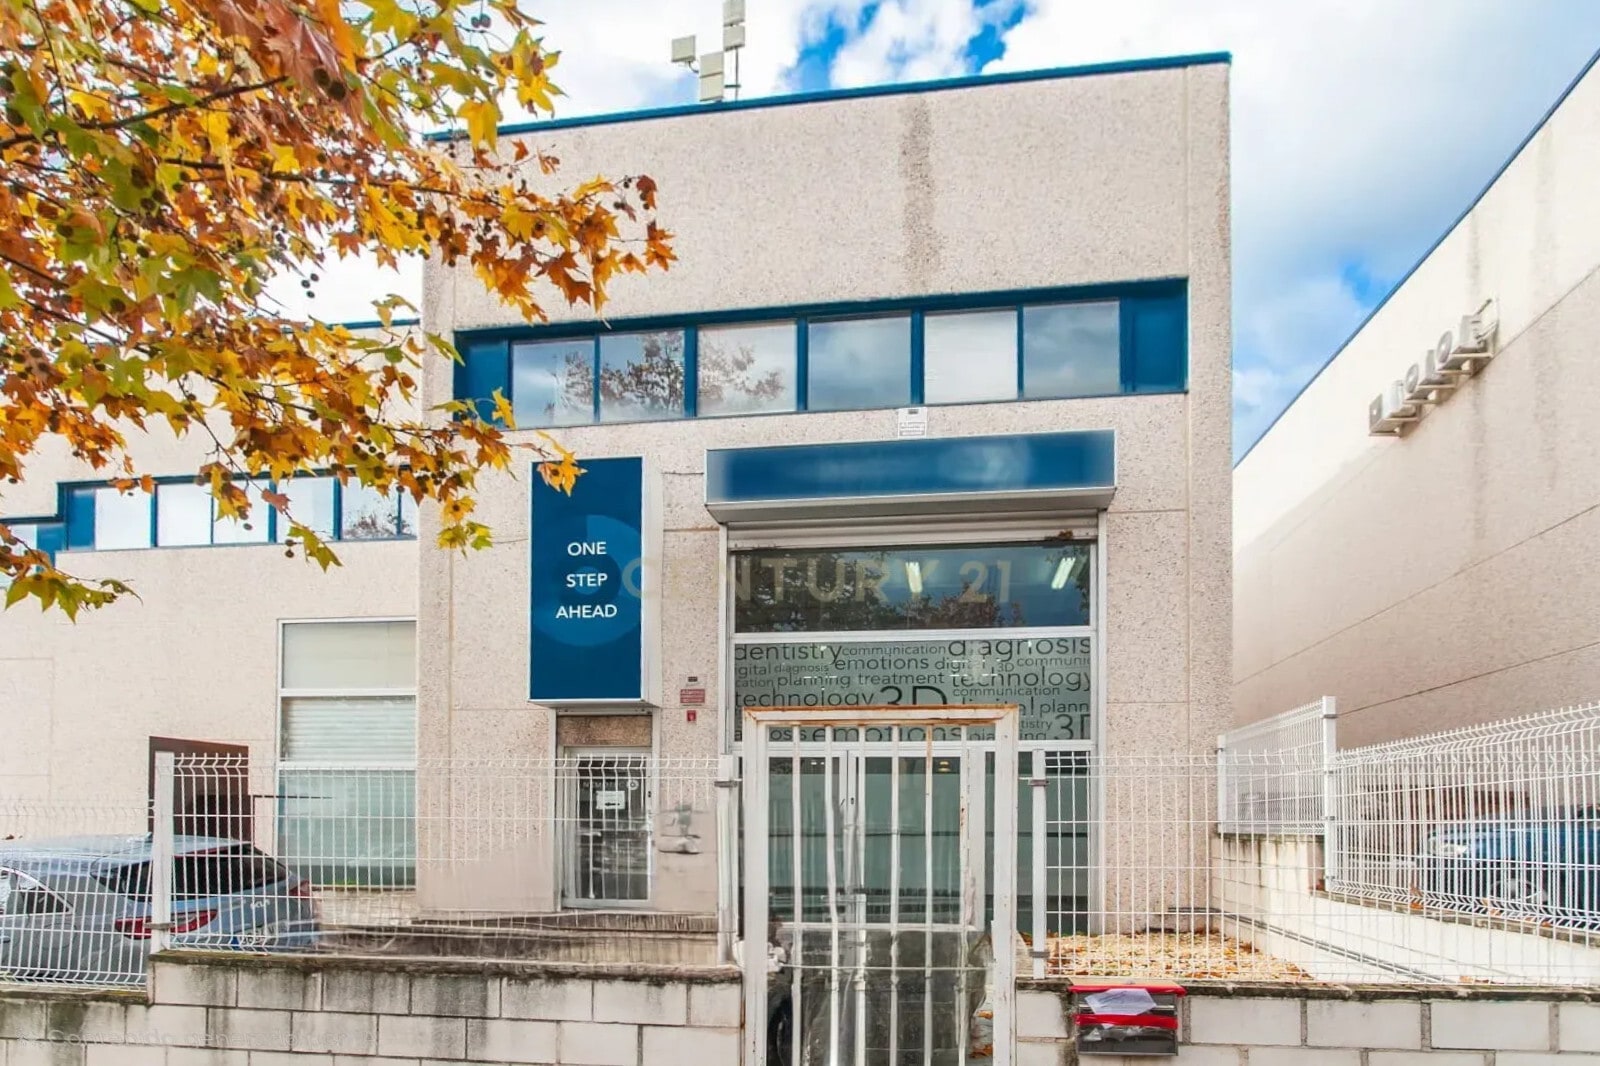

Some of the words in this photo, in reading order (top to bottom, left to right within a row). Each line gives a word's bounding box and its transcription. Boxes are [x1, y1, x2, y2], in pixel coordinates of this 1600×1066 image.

[567, 541, 607, 557] ONE
[566, 573, 608, 588] STEP
[555, 604, 618, 619] AHEAD
[735, 643, 842, 665] dentistry
[842, 644, 946, 656] communication
[774, 663, 829, 674] diagnosis
[835, 654, 929, 670] emotions
[934, 656, 986, 673] digil
[997, 662, 1015, 673] 3D
[778, 672, 851, 691] planning
[858, 672, 945, 686] treatment
[953, 685, 1060, 697] communication
